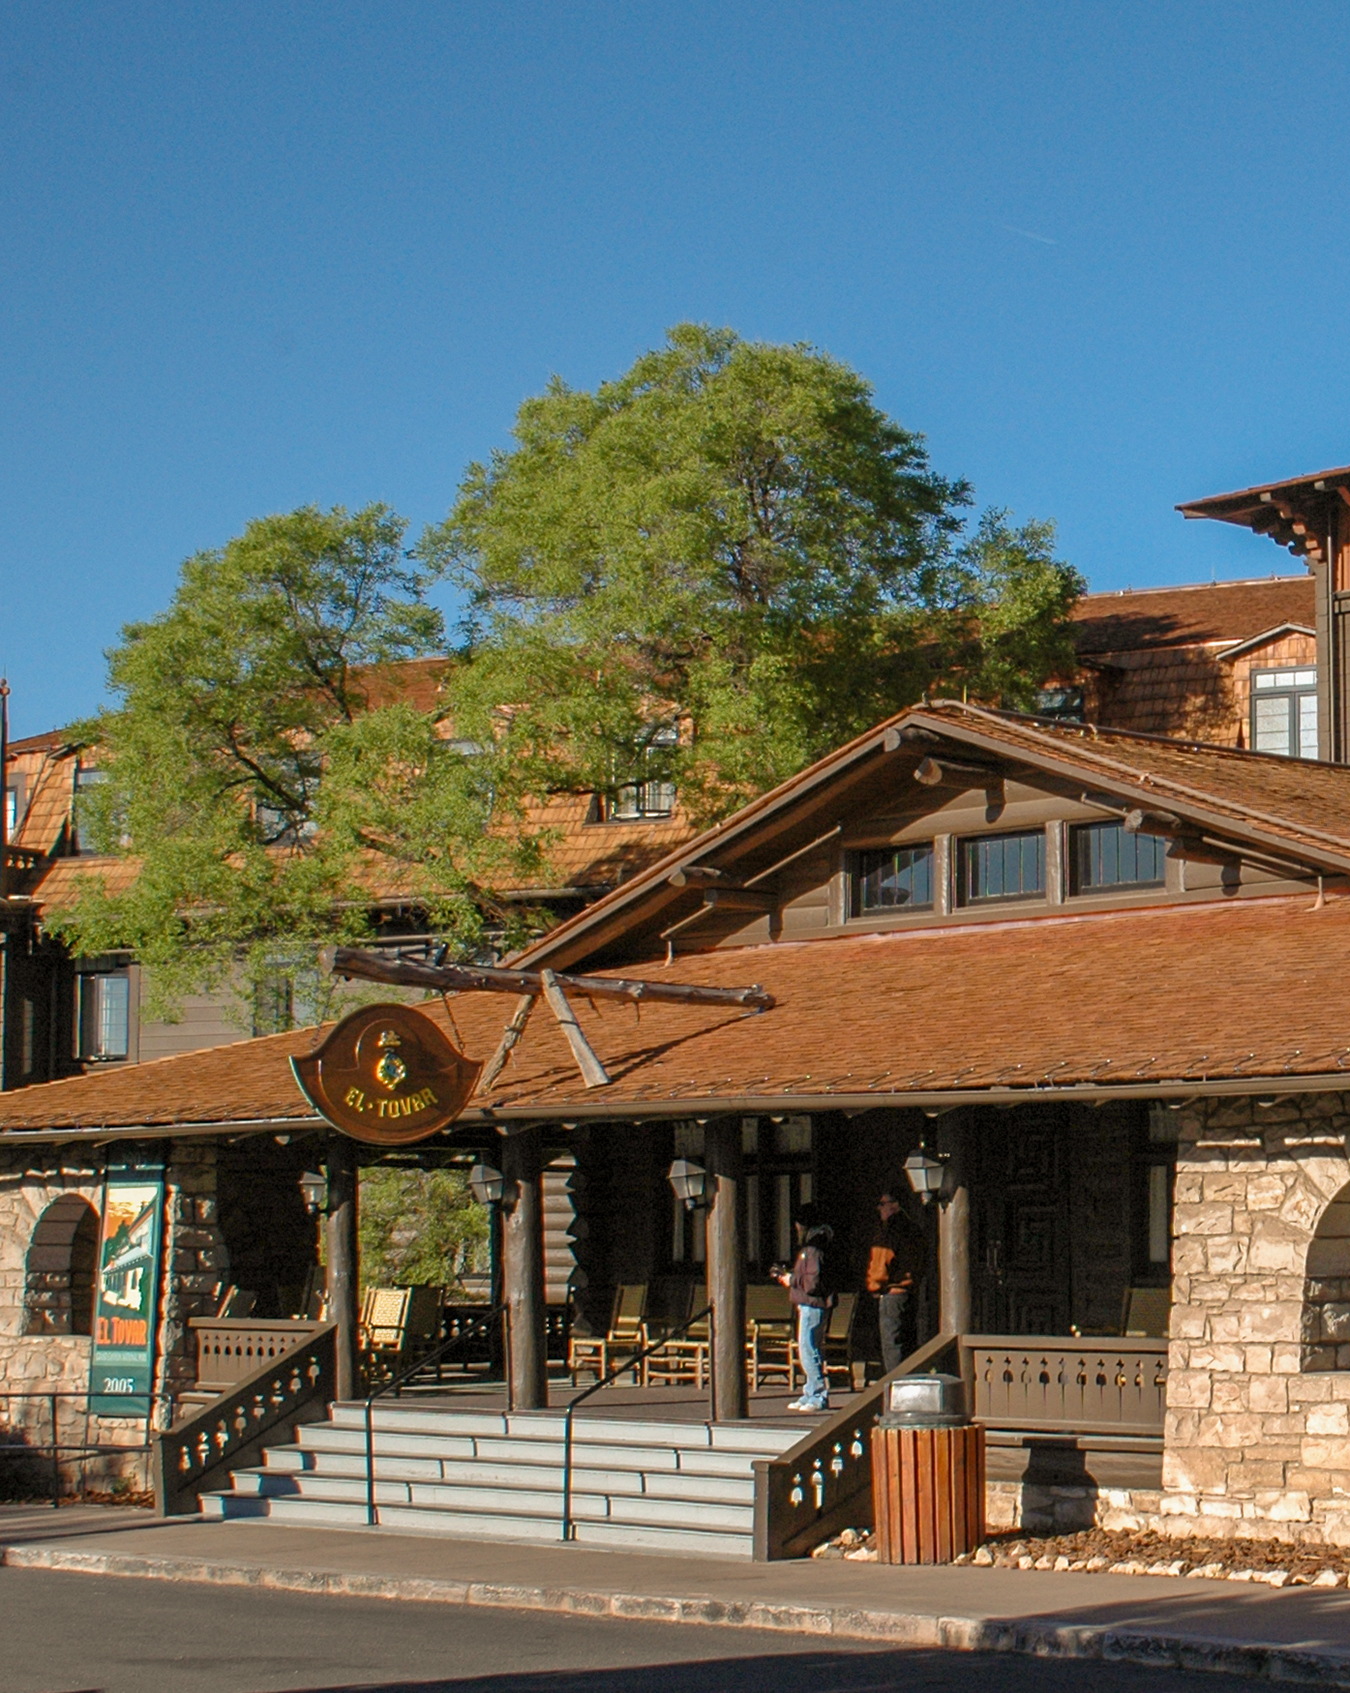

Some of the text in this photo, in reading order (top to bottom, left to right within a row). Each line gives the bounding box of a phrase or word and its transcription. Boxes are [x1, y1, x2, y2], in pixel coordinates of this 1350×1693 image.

[96, 1316, 147, 1345] EL TOVAR
[103, 1377, 134, 1393] 2005
